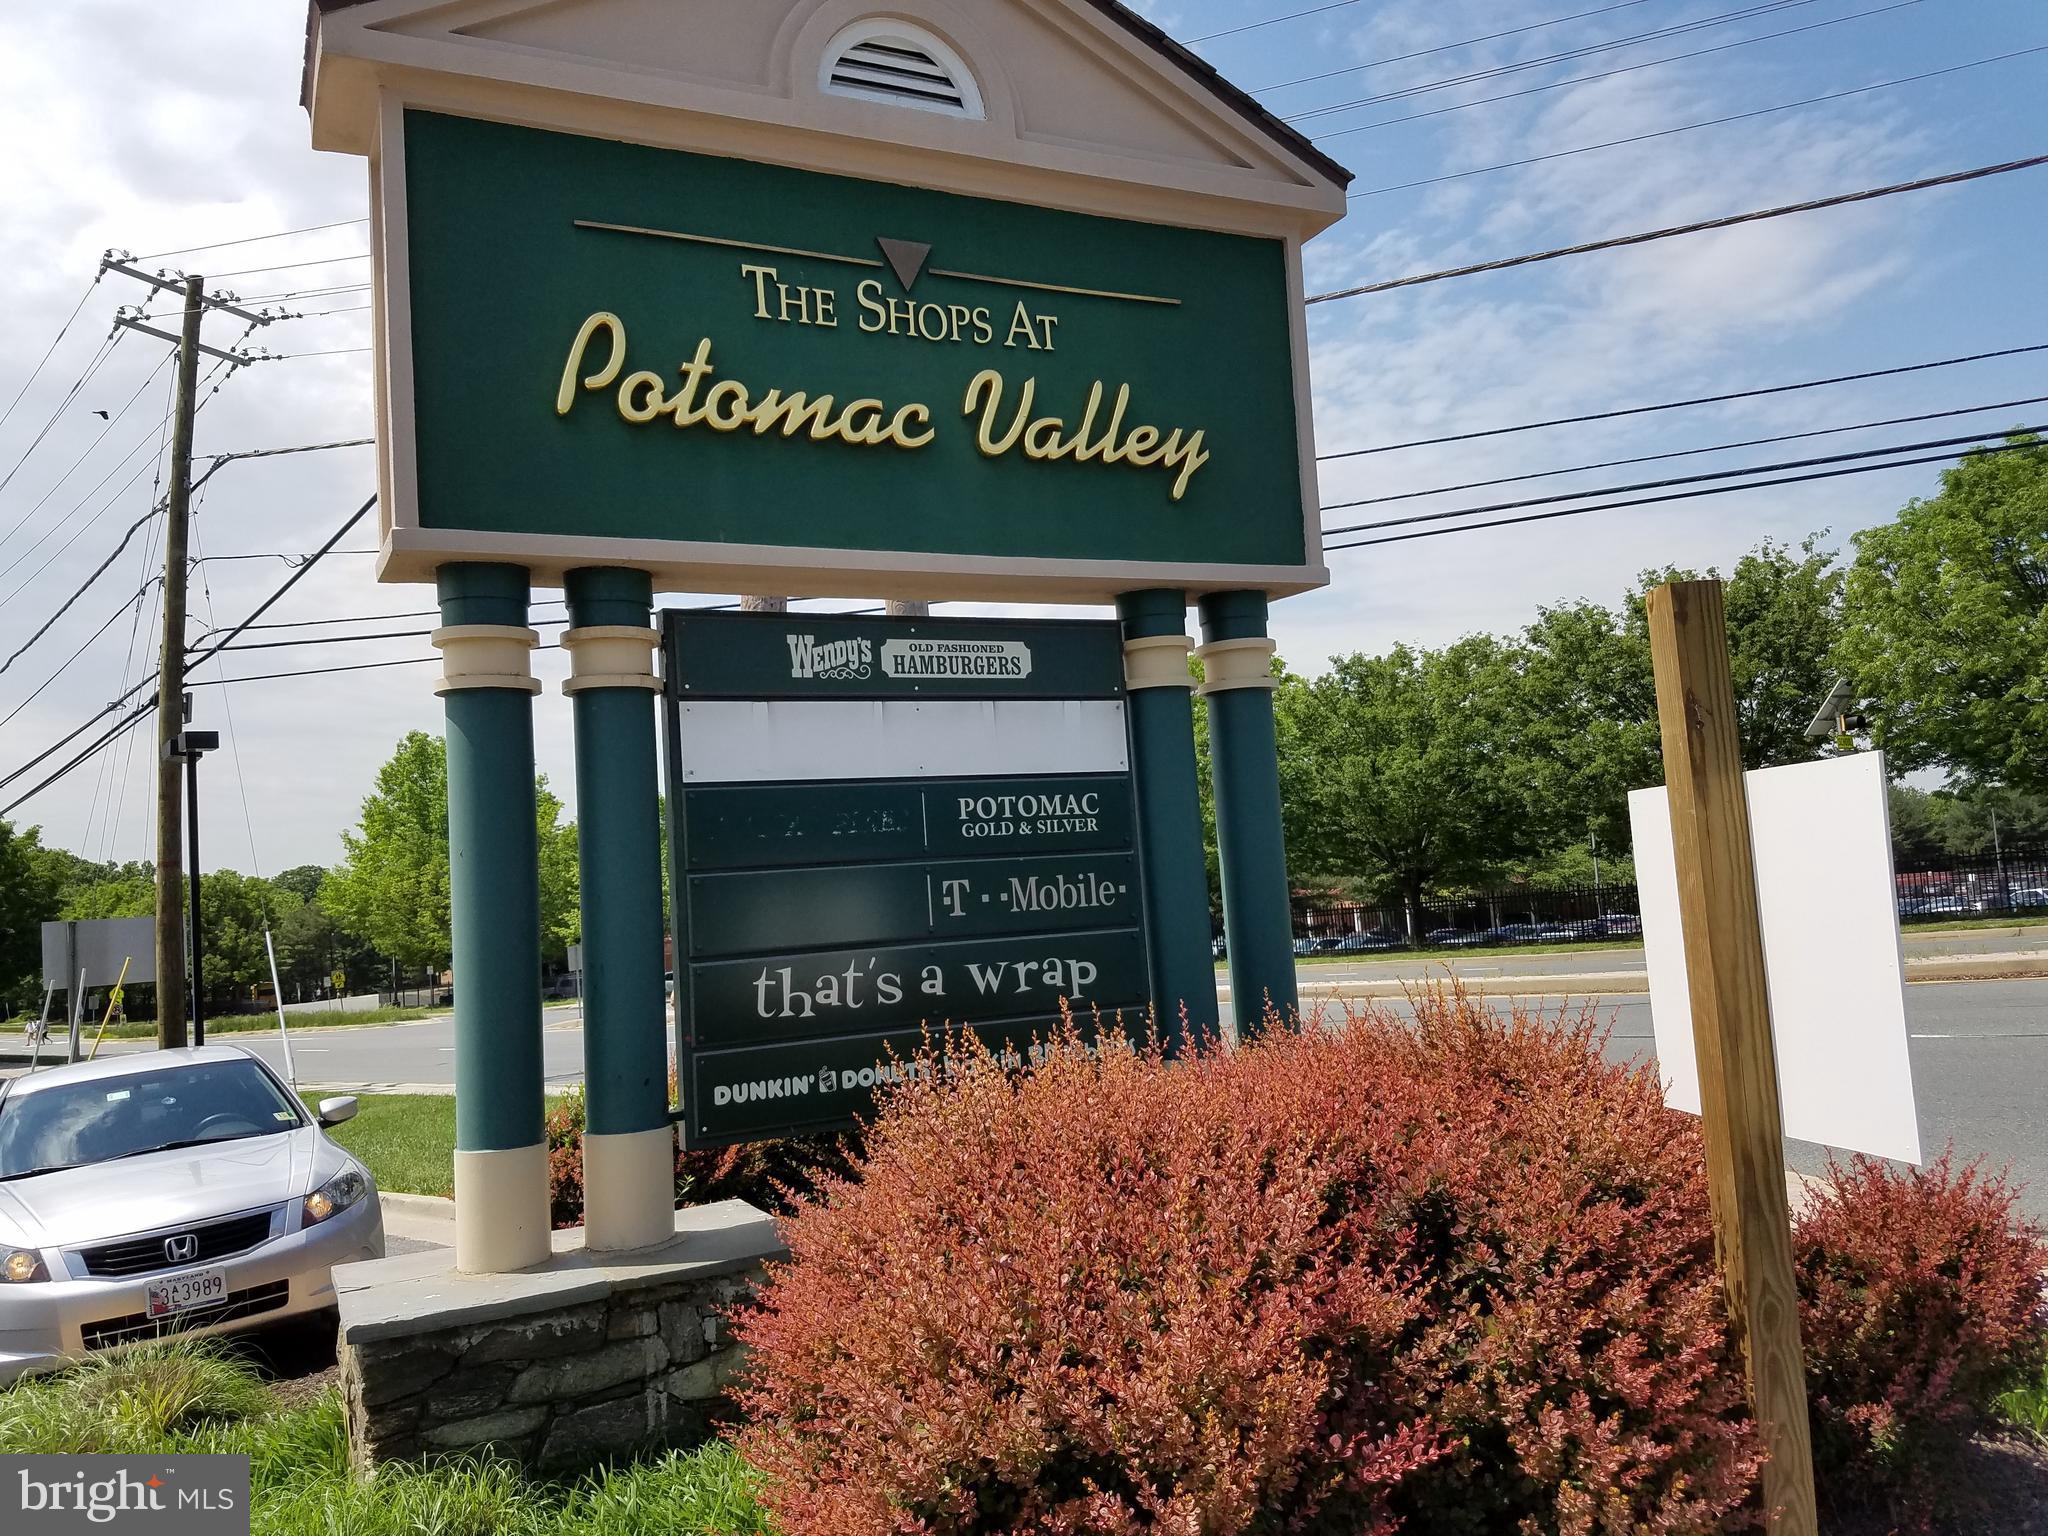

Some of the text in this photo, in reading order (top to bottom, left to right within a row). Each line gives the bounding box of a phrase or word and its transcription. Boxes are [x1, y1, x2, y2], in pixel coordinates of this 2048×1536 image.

[554, 311, 1210, 500] Potomac Valley
[908, 643, 1005, 654] OLD FASHIONED
[892, 654, 1023, 676] HAMBURGERS
[957, 792, 1100, 820] POTOMAC
[961, 817, 1100, 838] GOLD & SILVER
[752, 956, 1098, 1019] that's a wrap
[714, 1074, 815, 1106] DUNKIN'
[166, 1272, 204, 1283] MARYLAND
